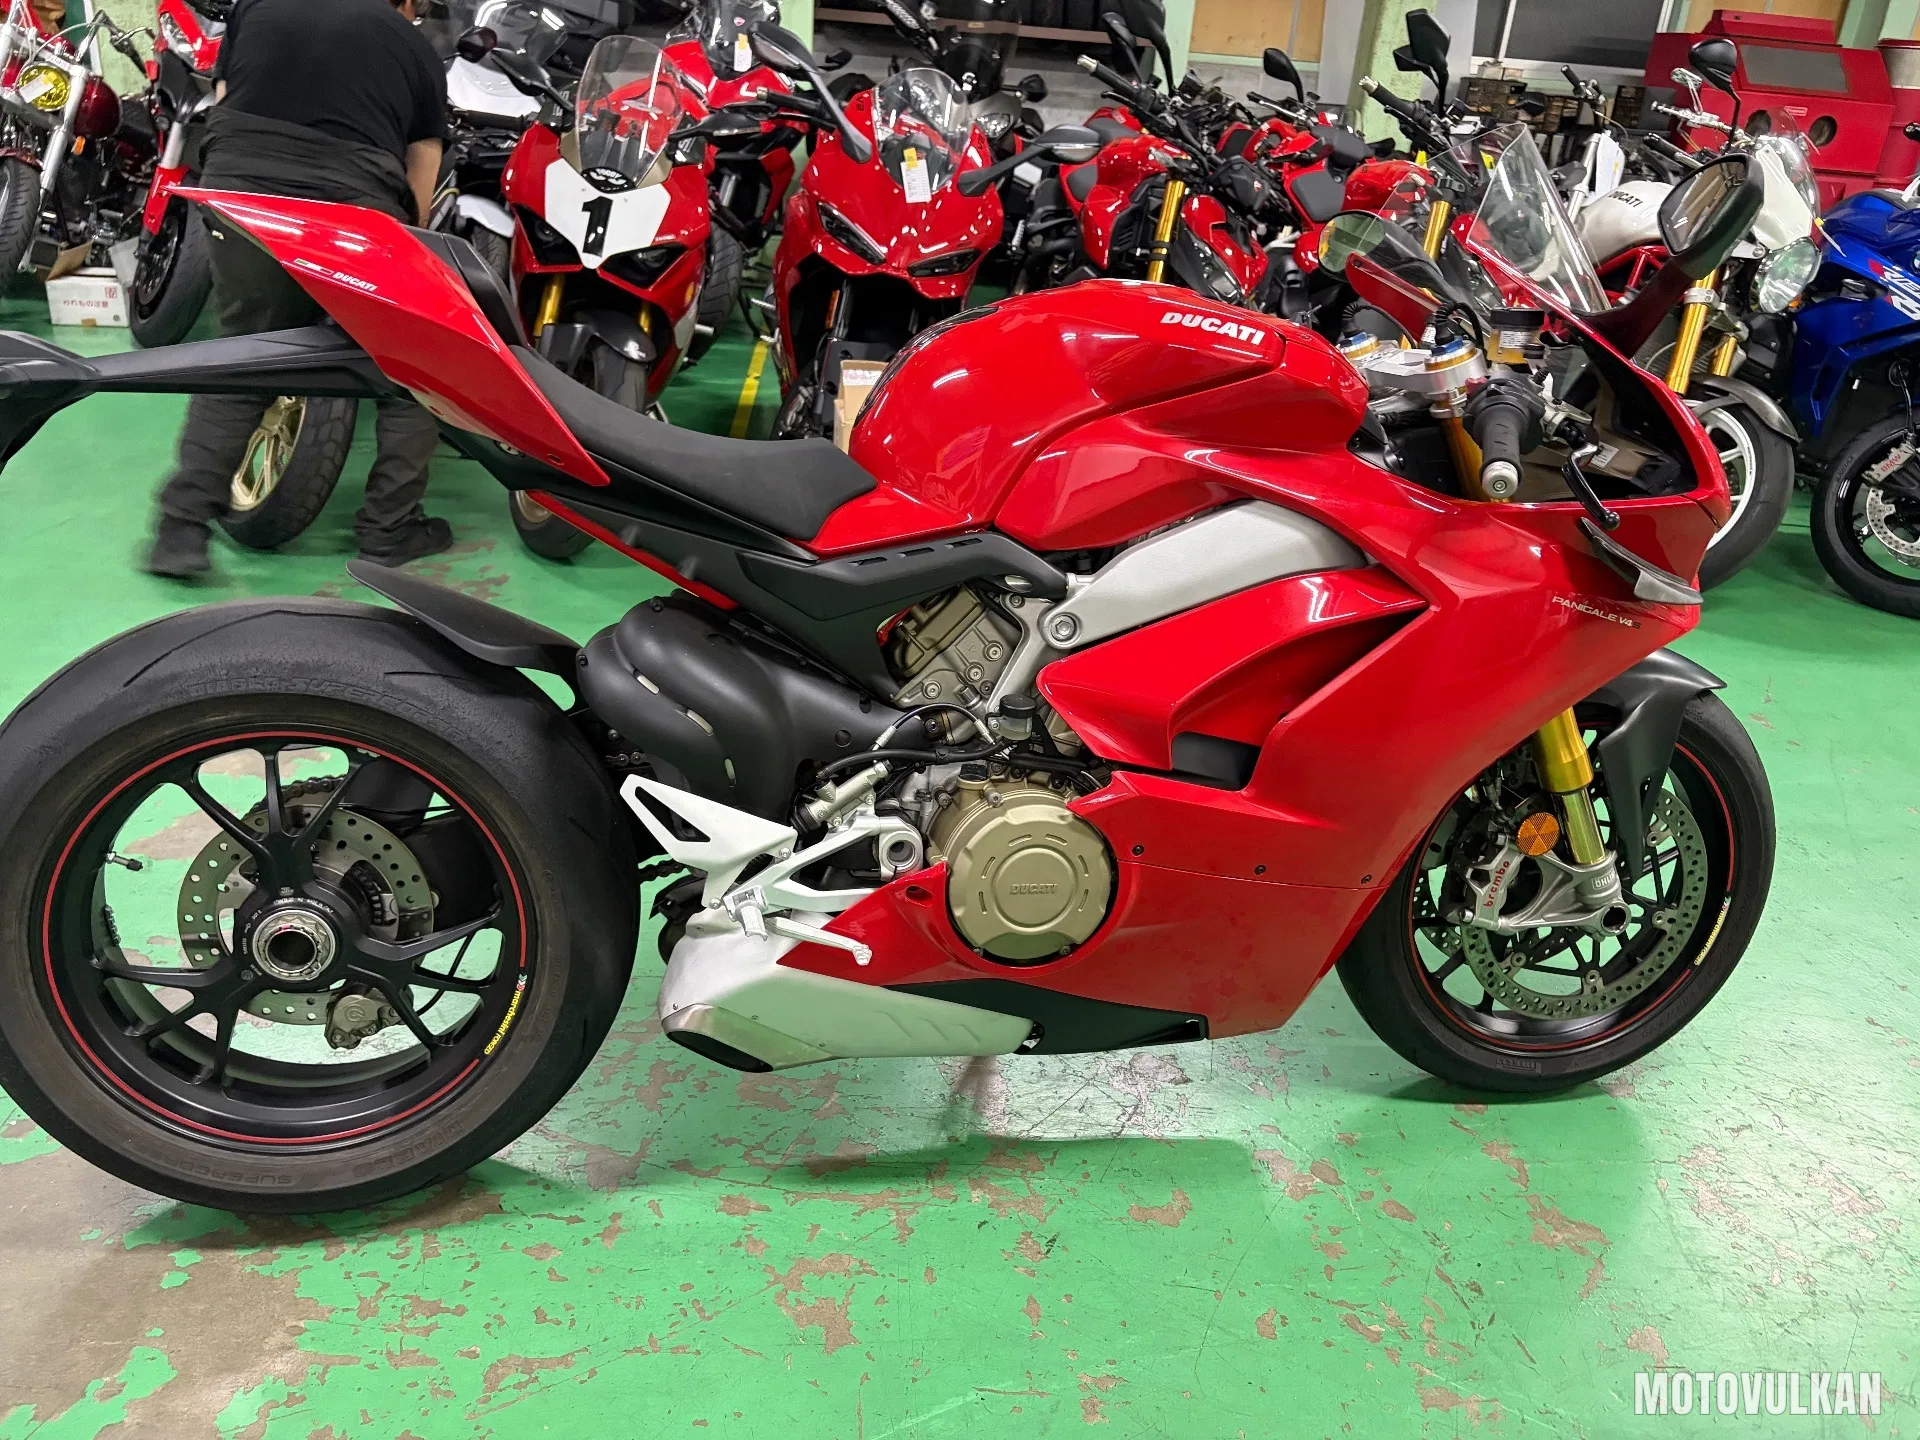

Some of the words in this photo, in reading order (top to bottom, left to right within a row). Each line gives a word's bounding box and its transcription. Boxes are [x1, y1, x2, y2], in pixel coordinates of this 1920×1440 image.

[581, 195, 614, 258] 1
[332, 271, 378, 292] DUCATI
[1160, 312, 1266, 346] DUCATI
[1880, 453, 1902, 473] BMW
[1551, 595, 1618, 622] PANIGALE
[1010, 883, 1058, 896] DUCATI
[1483, 860, 1511, 909] brembo
[498, 990, 522, 1035] marchesini
[483, 1033, 502, 1056] FORGED
